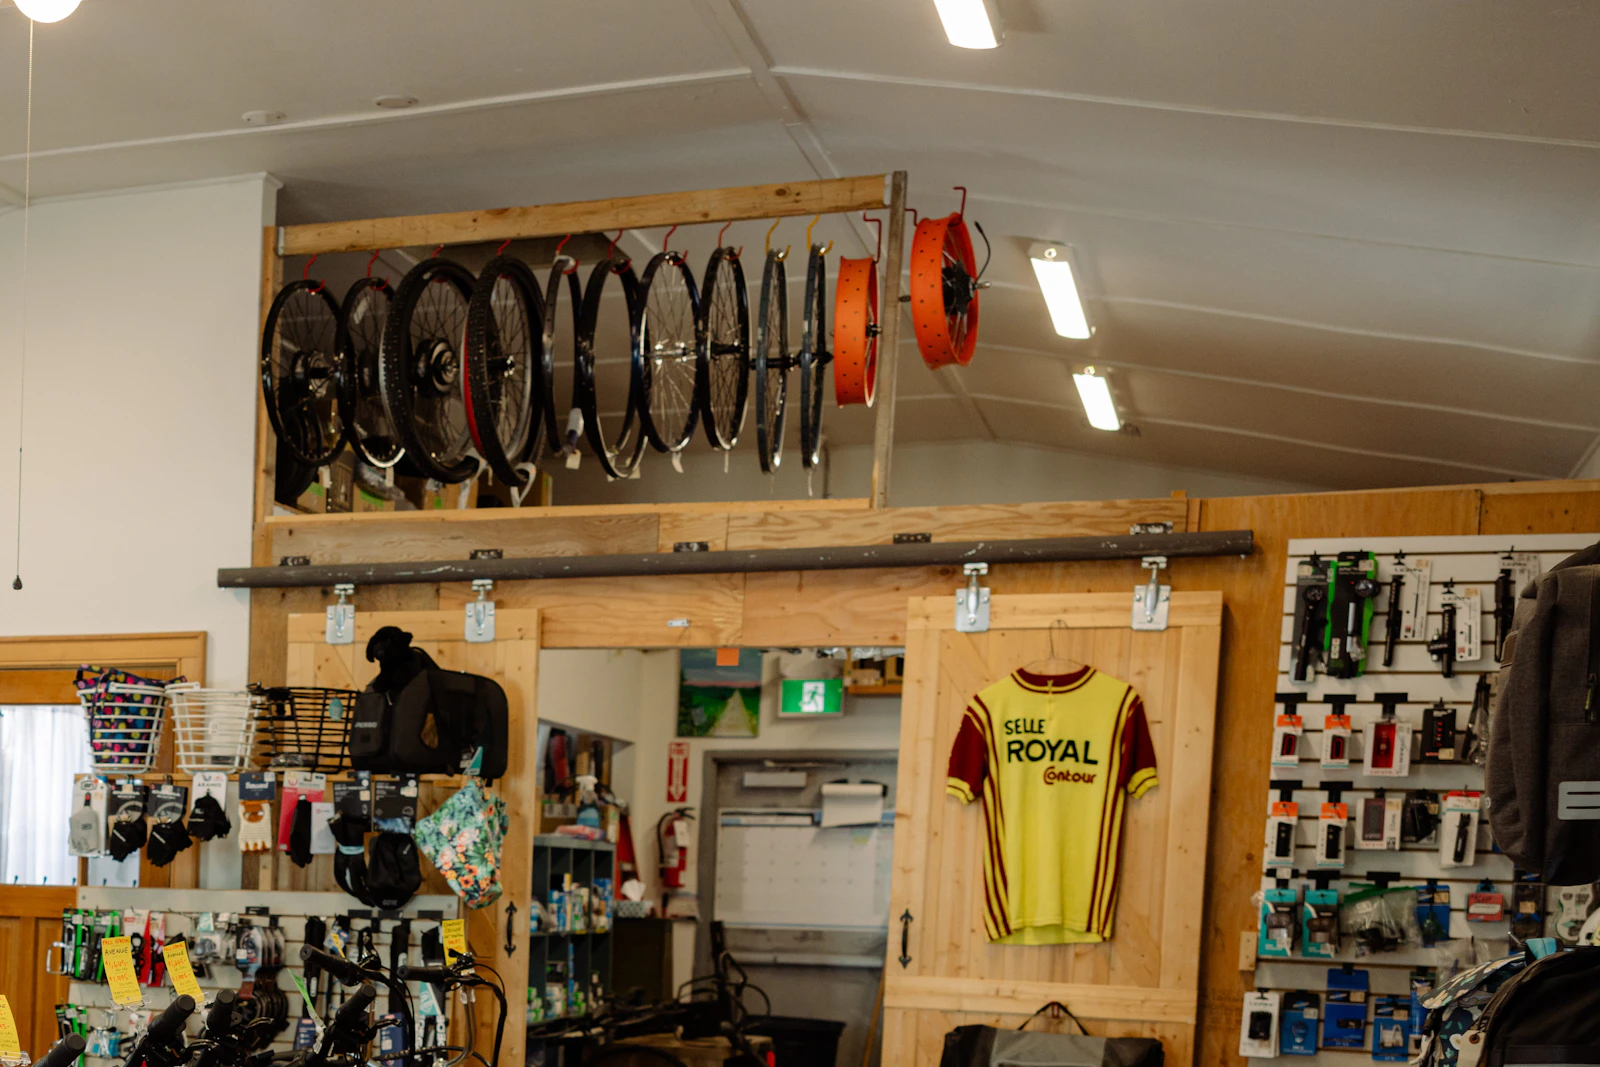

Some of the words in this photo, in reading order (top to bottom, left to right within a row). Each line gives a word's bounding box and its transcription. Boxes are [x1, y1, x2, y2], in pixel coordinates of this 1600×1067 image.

[1004, 718, 1046, 735] SELLE
[1007, 739, 1099, 765] ROYAL
[1043, 765, 1097, 785] Contour
[104, 946, 129, 955] AVENUE
